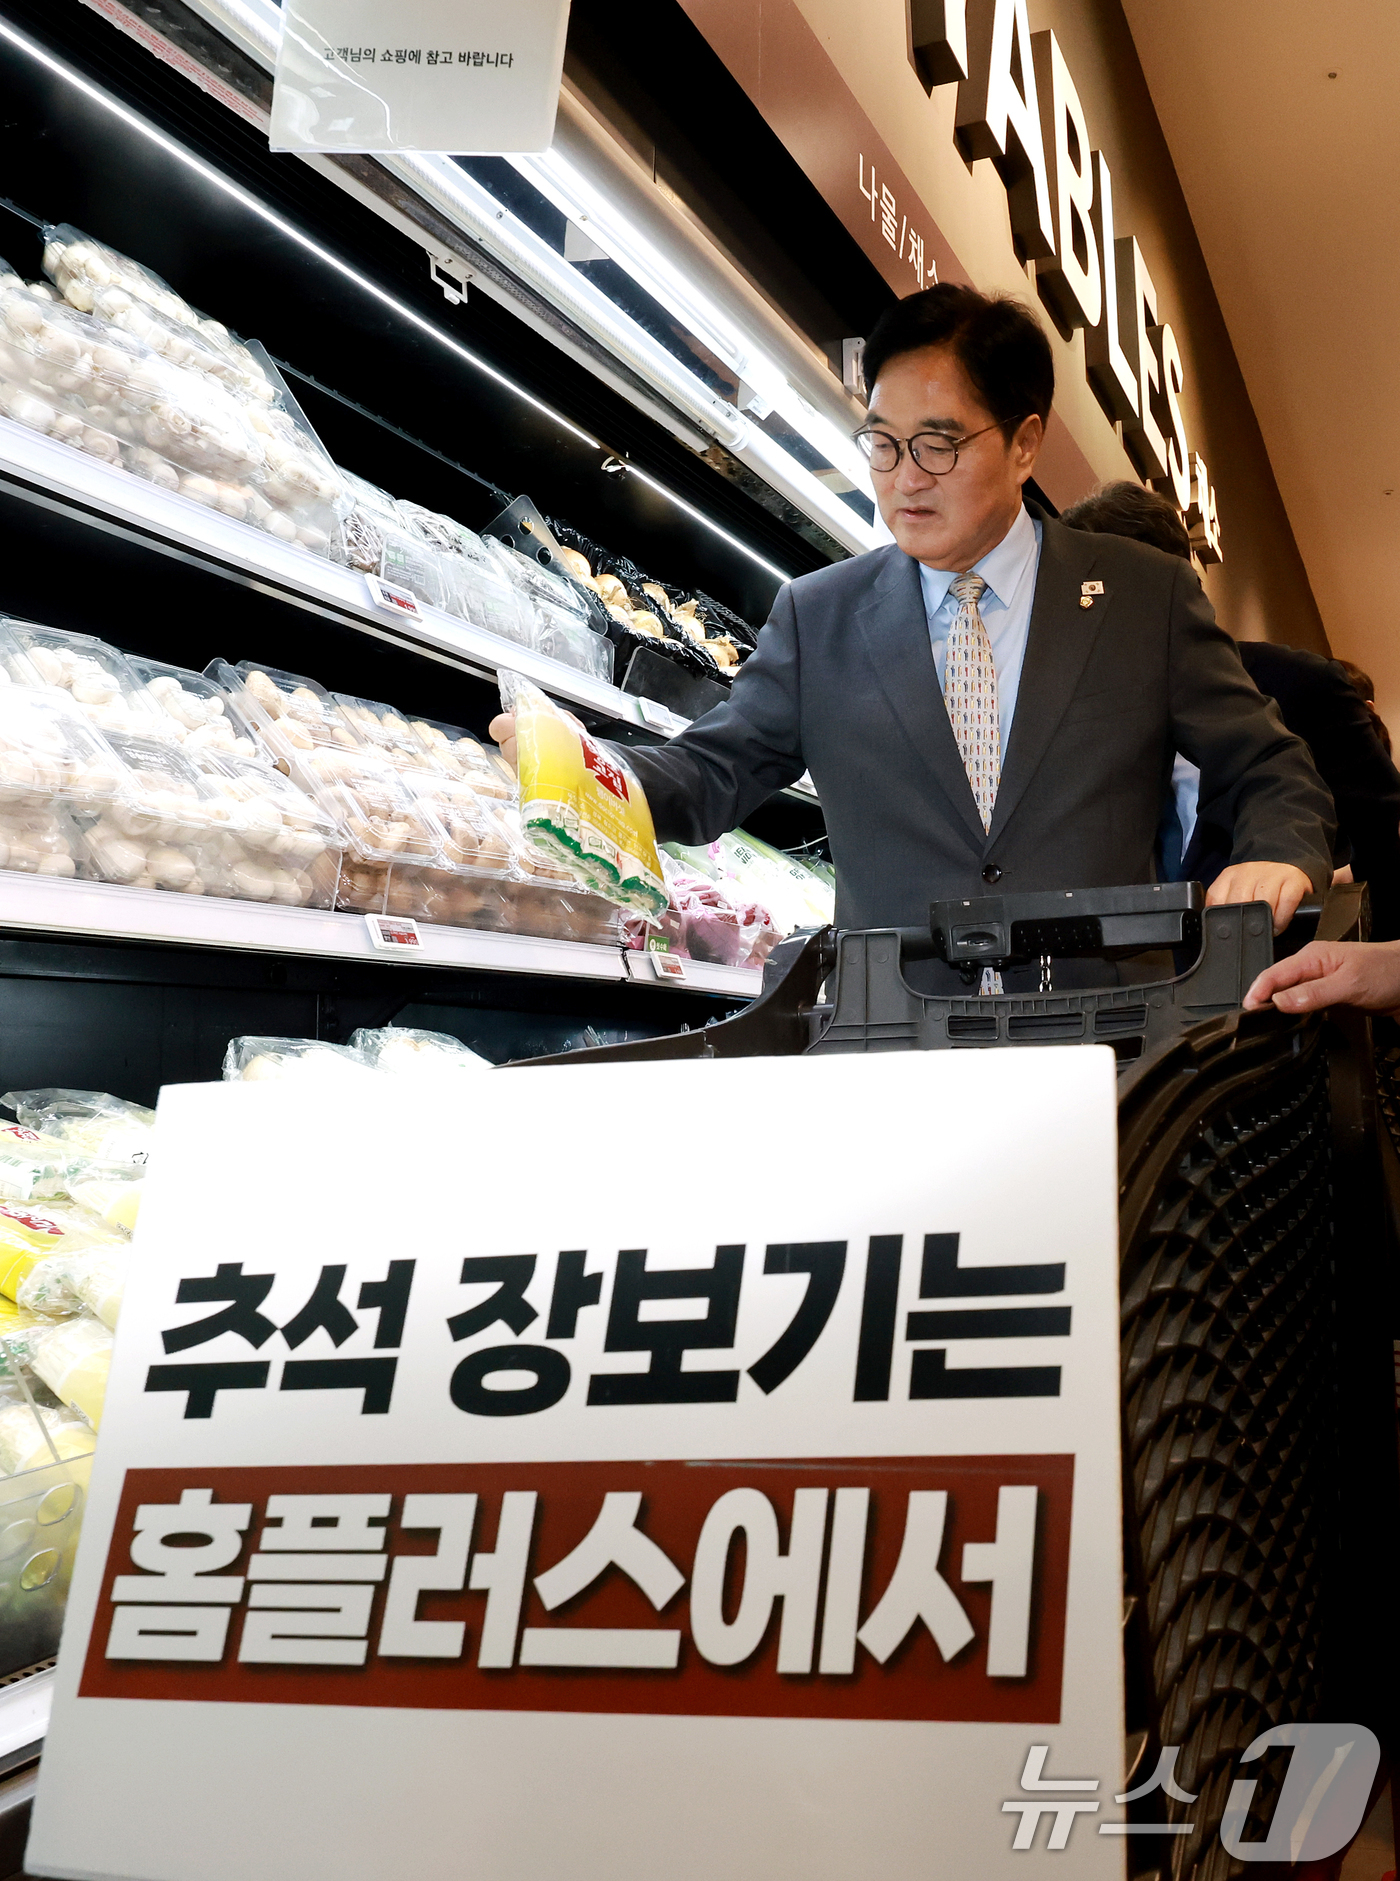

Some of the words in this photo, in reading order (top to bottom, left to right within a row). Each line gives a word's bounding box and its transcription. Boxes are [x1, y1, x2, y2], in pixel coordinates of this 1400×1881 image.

[324, 47, 376, 63] 고객님의
[380, 49, 422, 65] 쇼핑에
[426, 50, 453, 65] 참고
[458, 52, 515, 68] 바랍니다
[144, 1258, 417, 1420] 추석
[446, 1231, 1073, 1418] 장보기는
[104, 1485, 1039, 1678] 홈플러스에서
